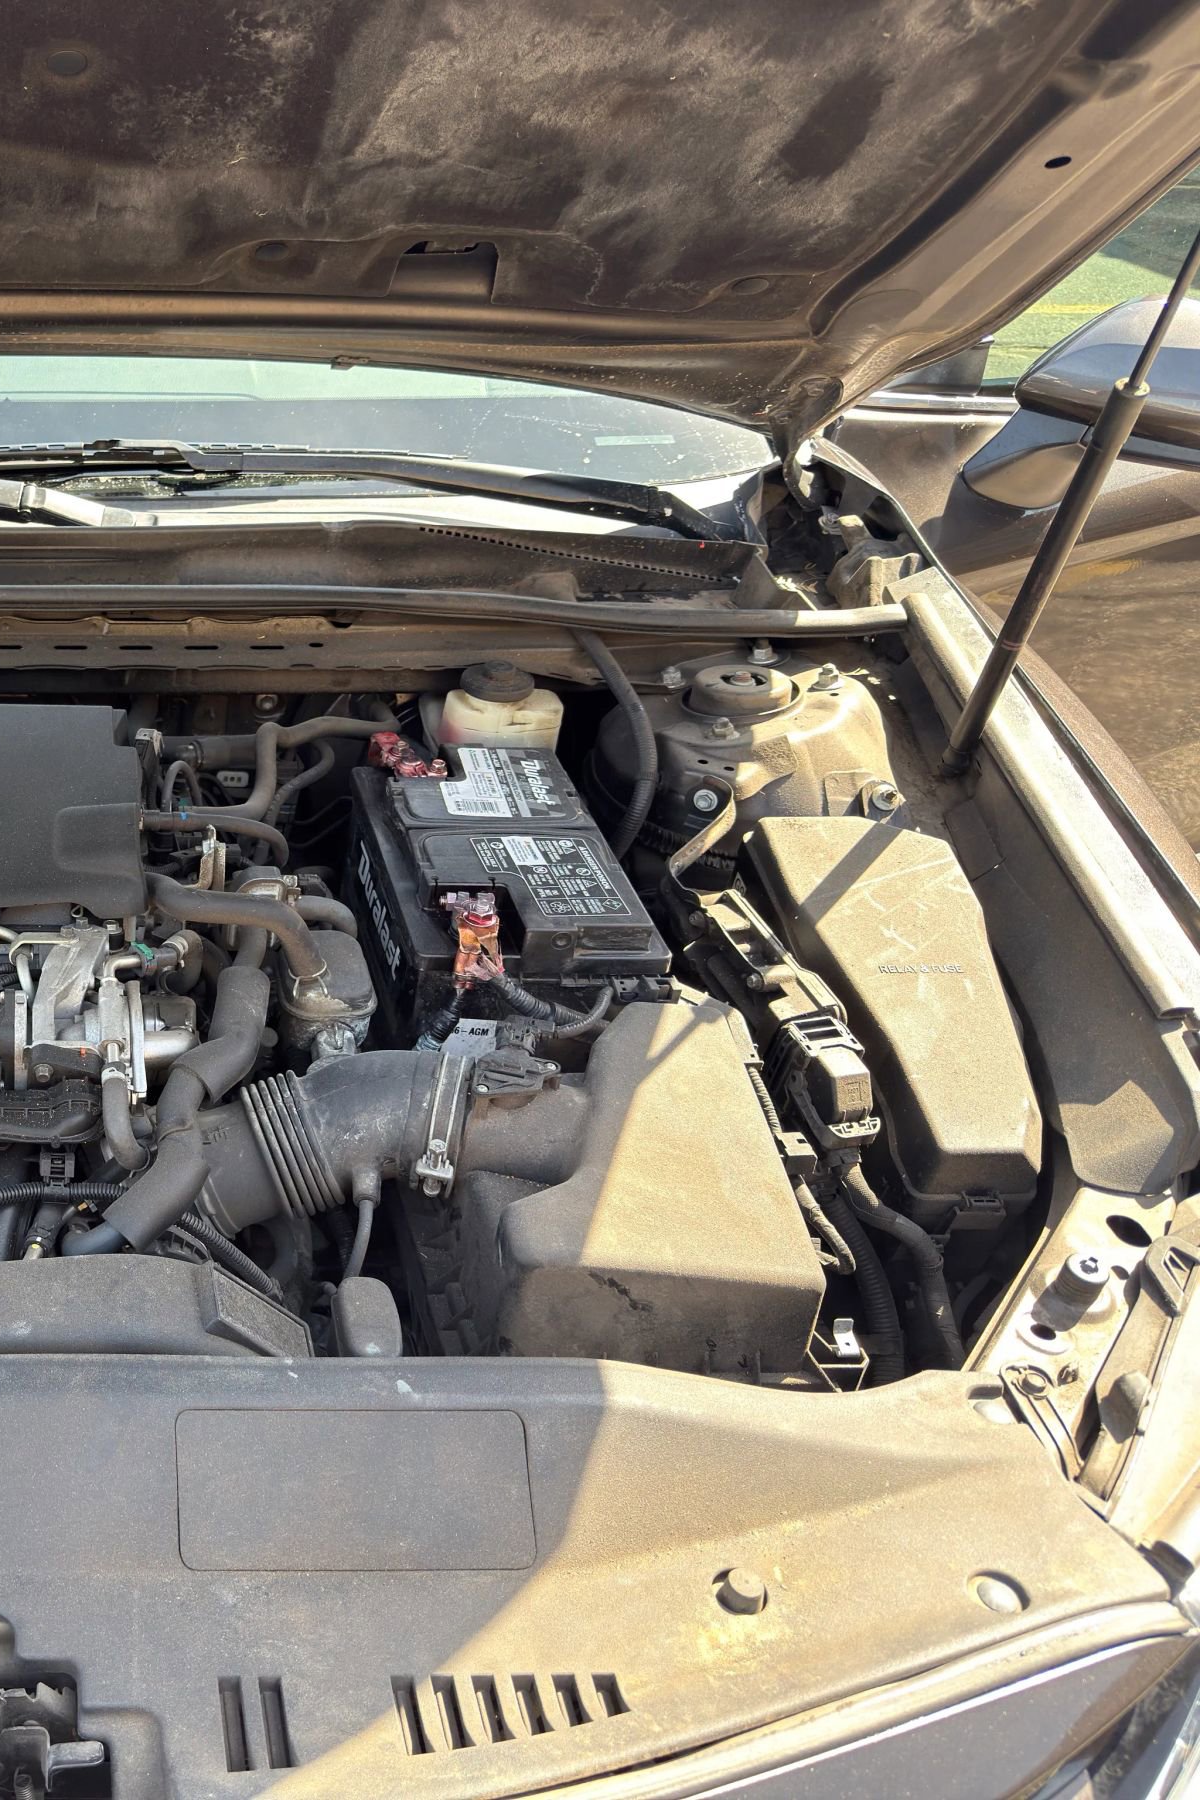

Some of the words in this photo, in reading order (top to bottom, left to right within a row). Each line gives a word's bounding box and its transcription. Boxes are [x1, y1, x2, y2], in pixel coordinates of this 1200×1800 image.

[520, 759, 556, 806] Duralast
[358, 839, 400, 982] Duralast
[878, 965, 917, 974] RELAY
[920, 963, 929, 973] &
[931, 964, 964, 974] FUSE
